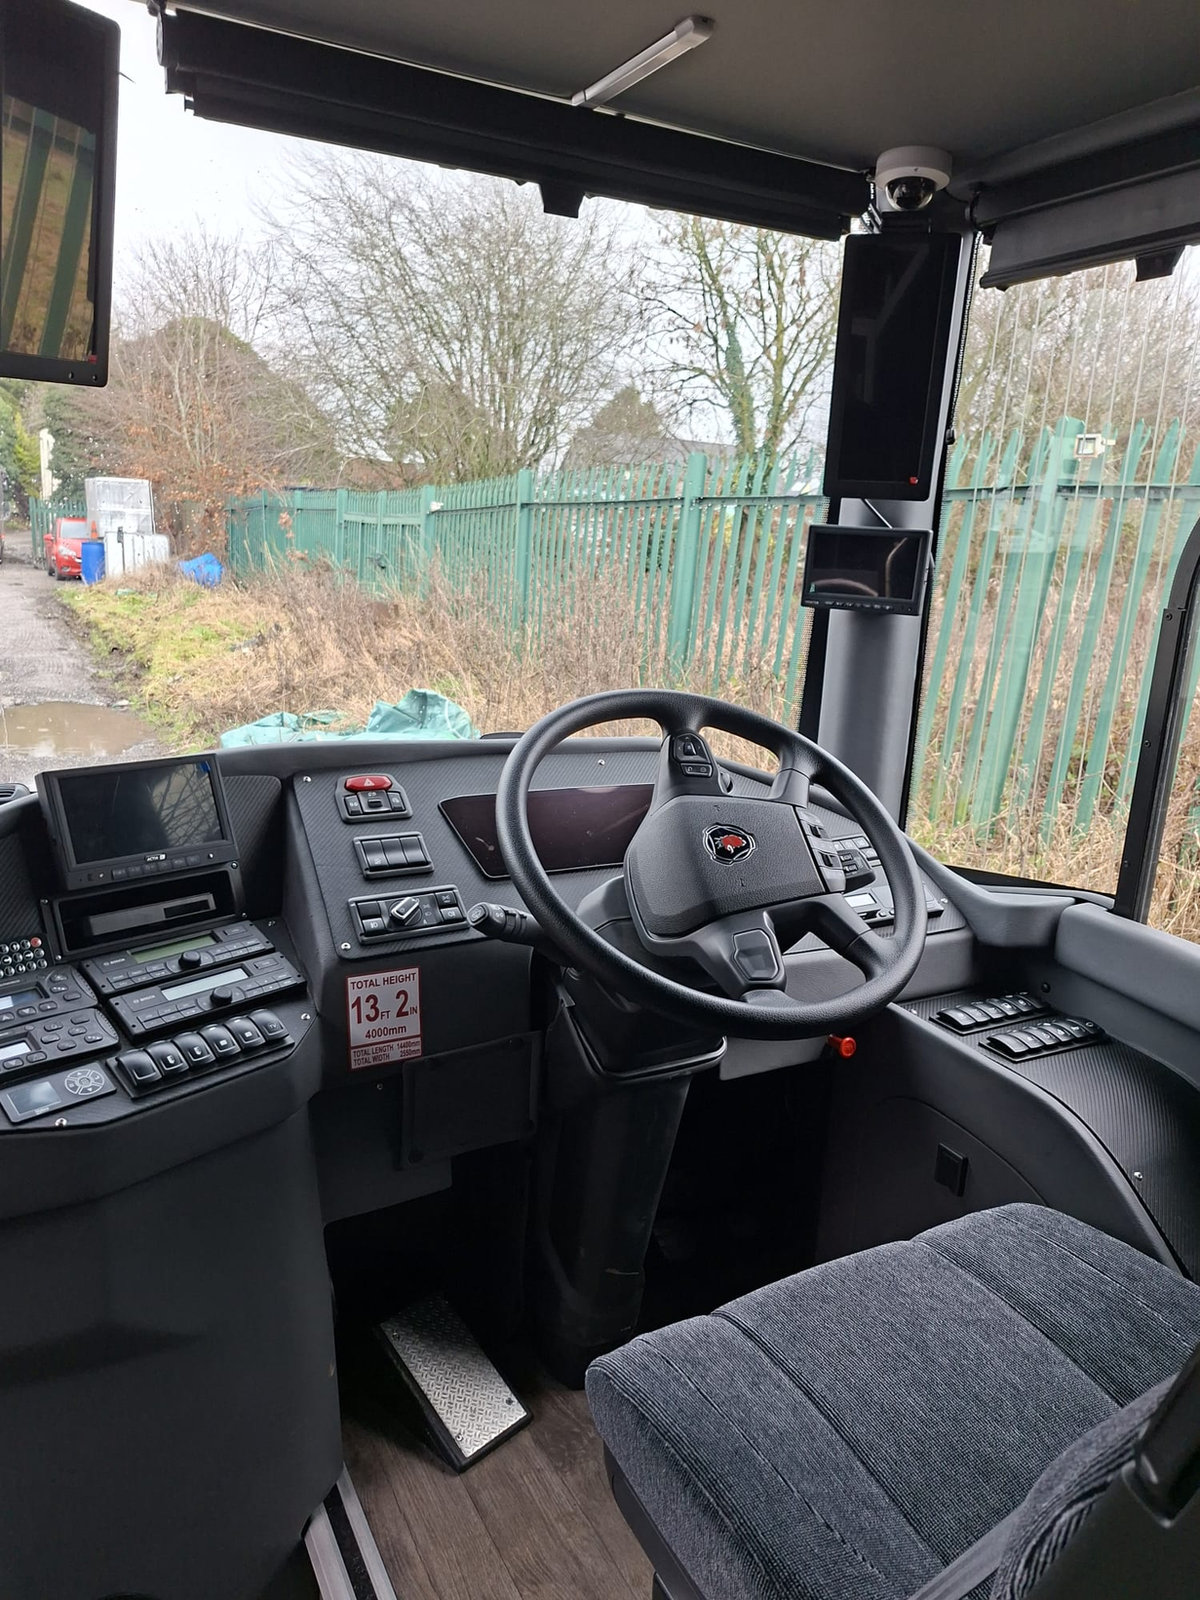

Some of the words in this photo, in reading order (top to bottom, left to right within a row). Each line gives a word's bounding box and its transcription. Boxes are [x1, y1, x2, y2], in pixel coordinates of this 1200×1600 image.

[350, 979, 380, 990] TOTAL
[383, 973, 416, 985] HEIGHT
[365, 1025, 407, 1039] 4000mm
[353, 1050, 371, 1058] TOTAL
[372, 1044, 394, 1055] LENGTH
[353, 1056, 371, 1067] TOTAL
[372, 1053, 390, 1063] WIDTH
